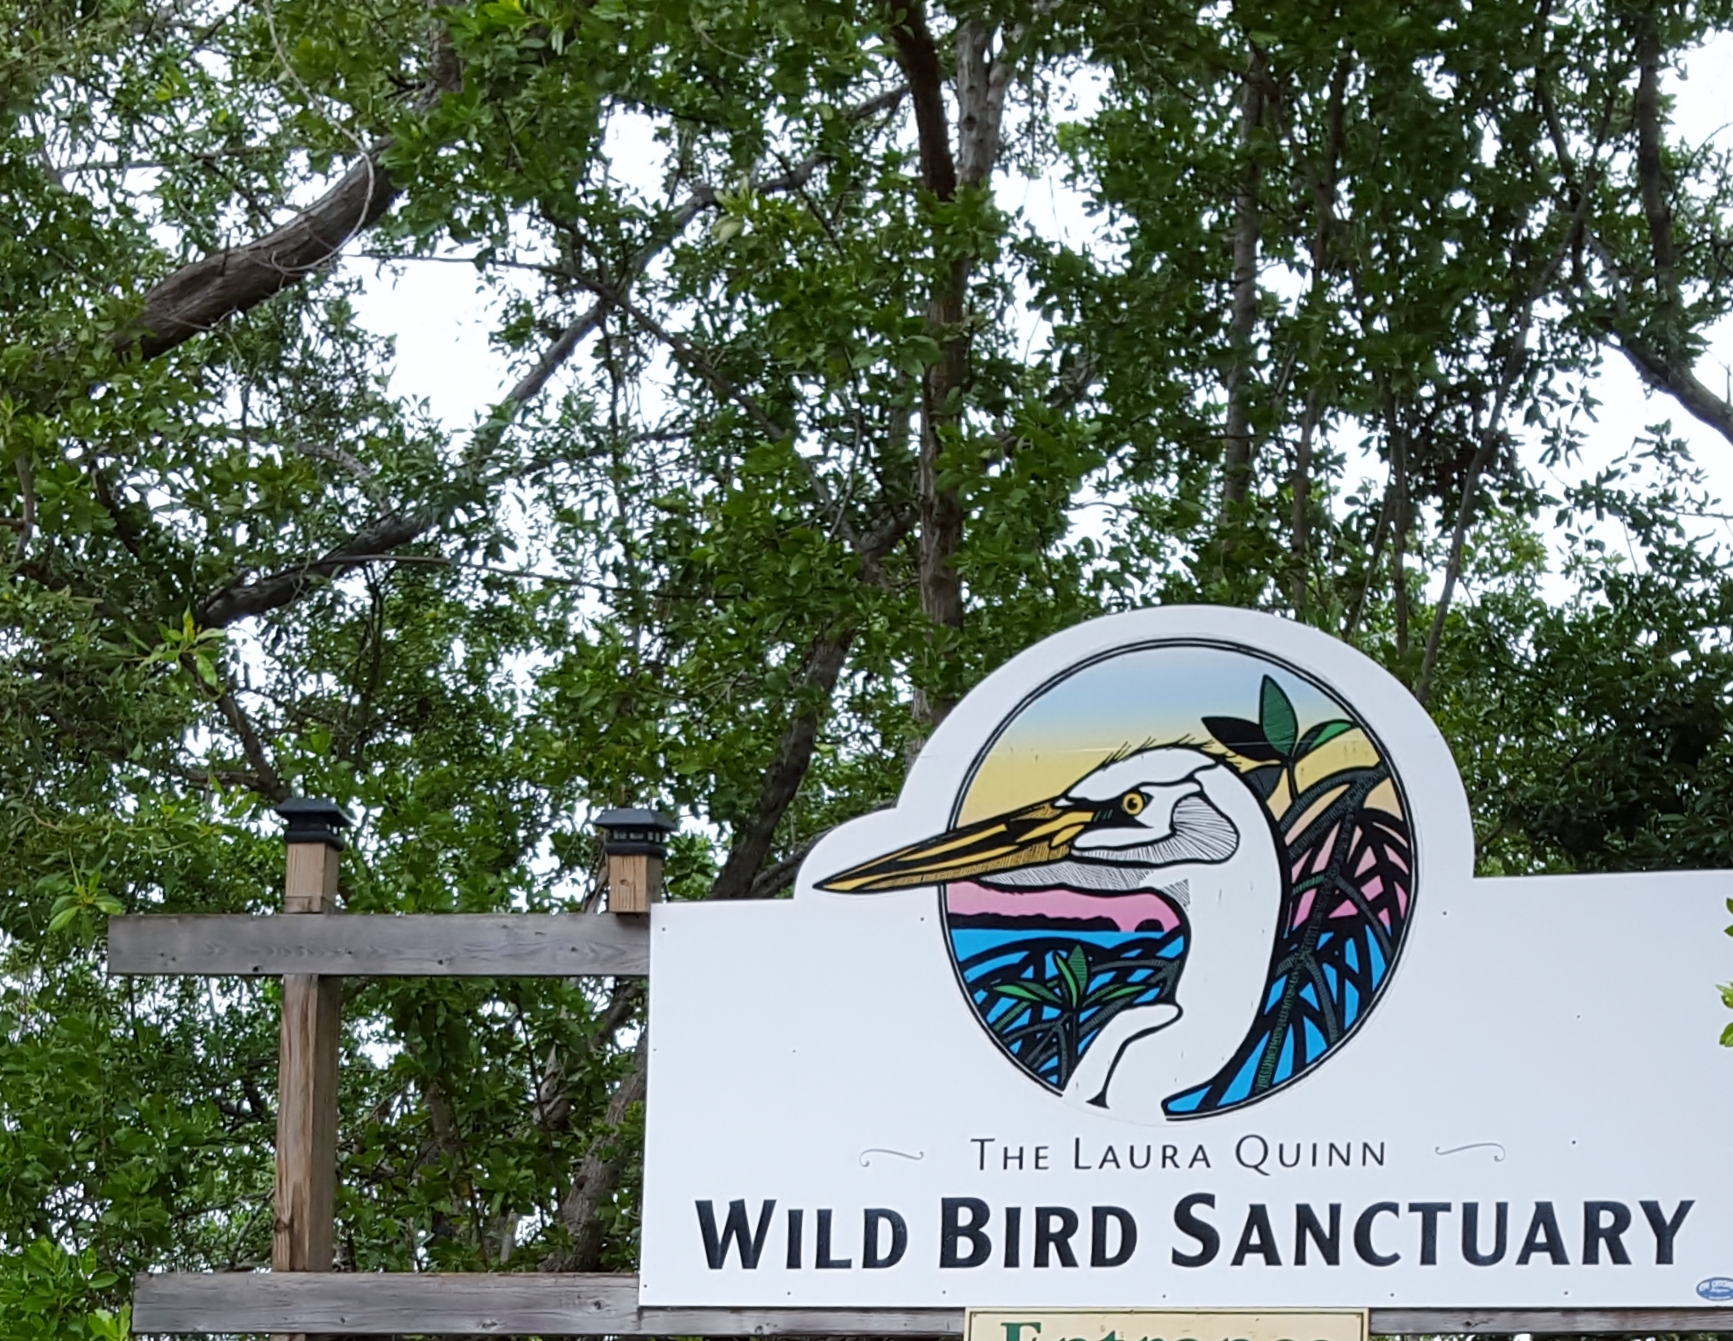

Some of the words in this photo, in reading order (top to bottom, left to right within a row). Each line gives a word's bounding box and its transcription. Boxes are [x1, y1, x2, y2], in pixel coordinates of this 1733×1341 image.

[970, 1138, 1050, 1171] THE
[1074, 1137, 1211, 1170] LAURA
[1235, 1134, 1386, 1176] QUINN
[695, 1198, 909, 1270] WILD
[940, 1196, 1138, 1269] BIRD
[1172, 1192, 1696, 1268] SANCTUARY
